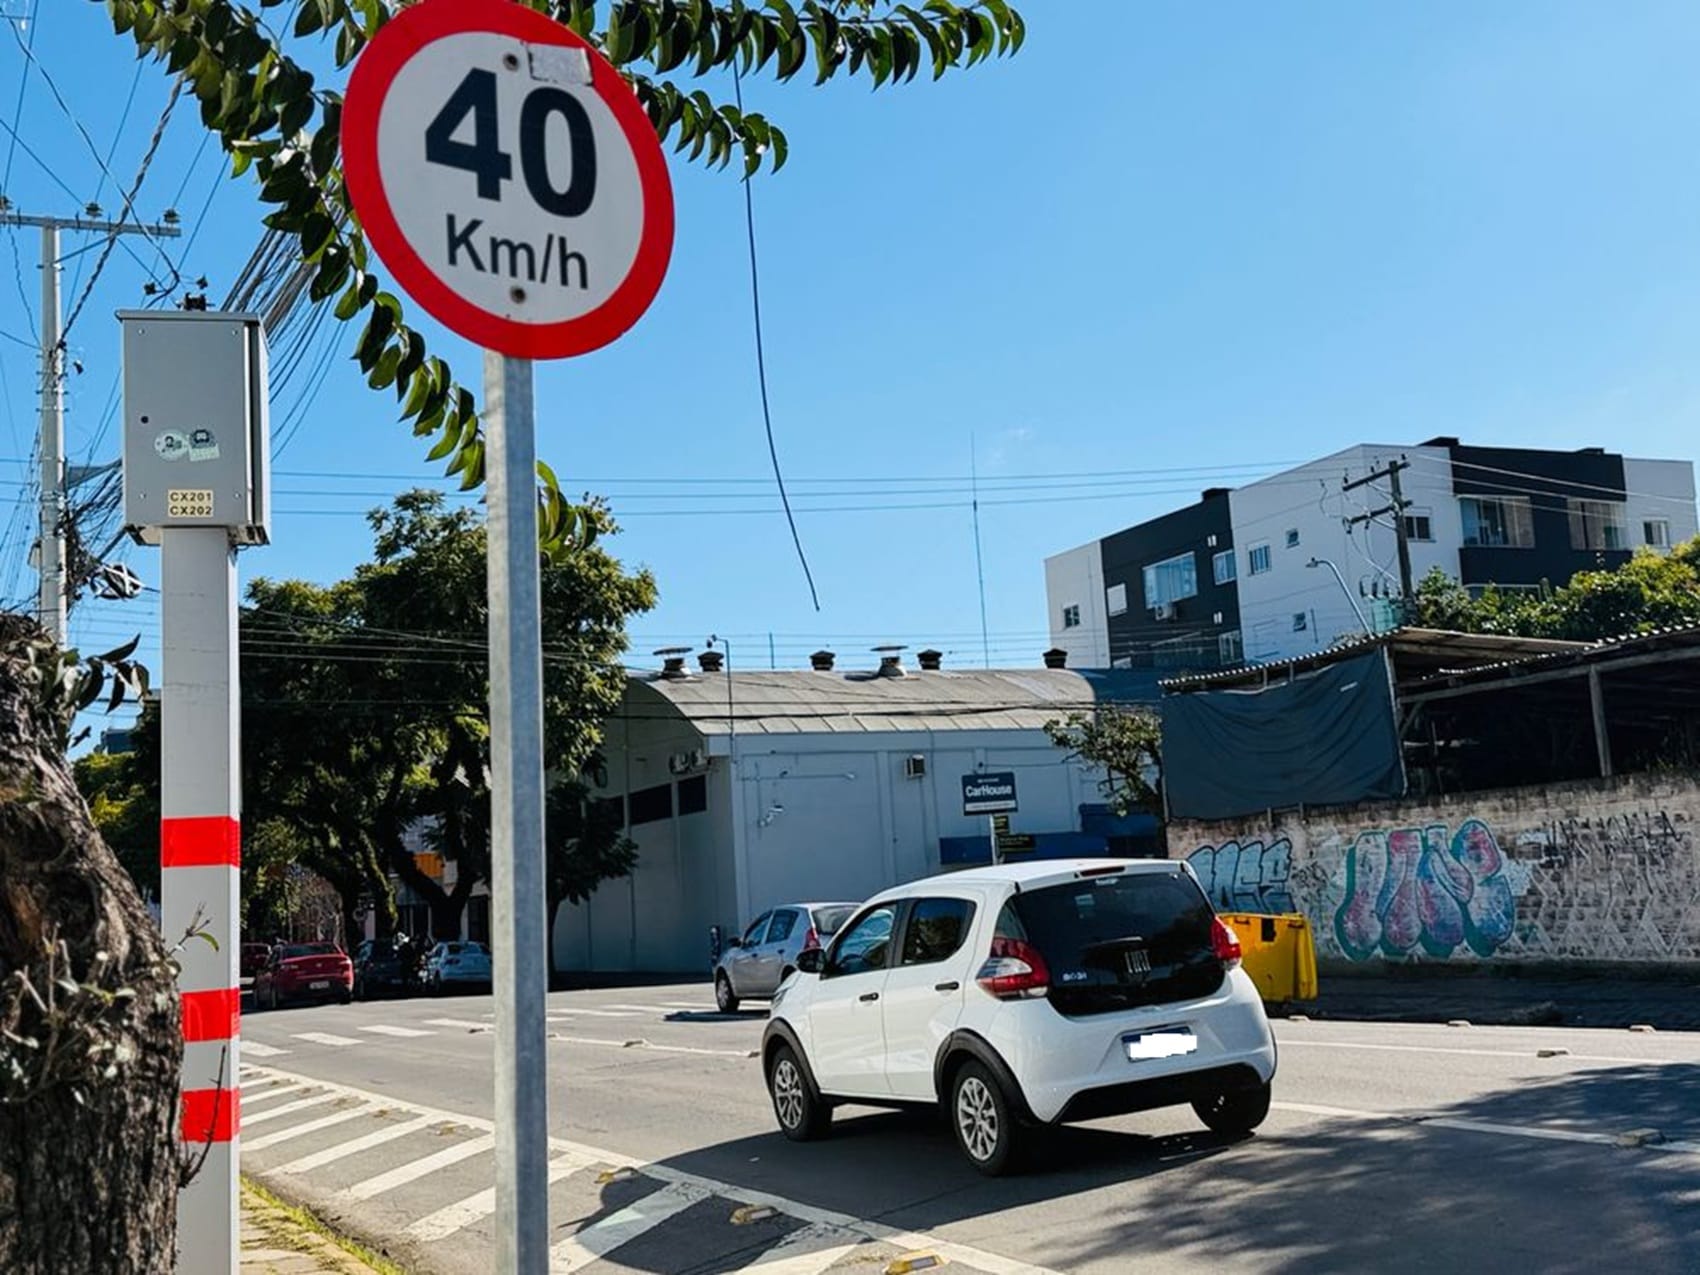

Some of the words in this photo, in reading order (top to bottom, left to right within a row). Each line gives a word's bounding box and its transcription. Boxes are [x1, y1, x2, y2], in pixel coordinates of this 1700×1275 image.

[425, 67, 597, 218] 40
[446, 213, 588, 290] Km/h
[170, 492, 211, 502] CX201
[170, 506, 212, 515] CX202
[965, 785, 1012, 797] CarHouse
